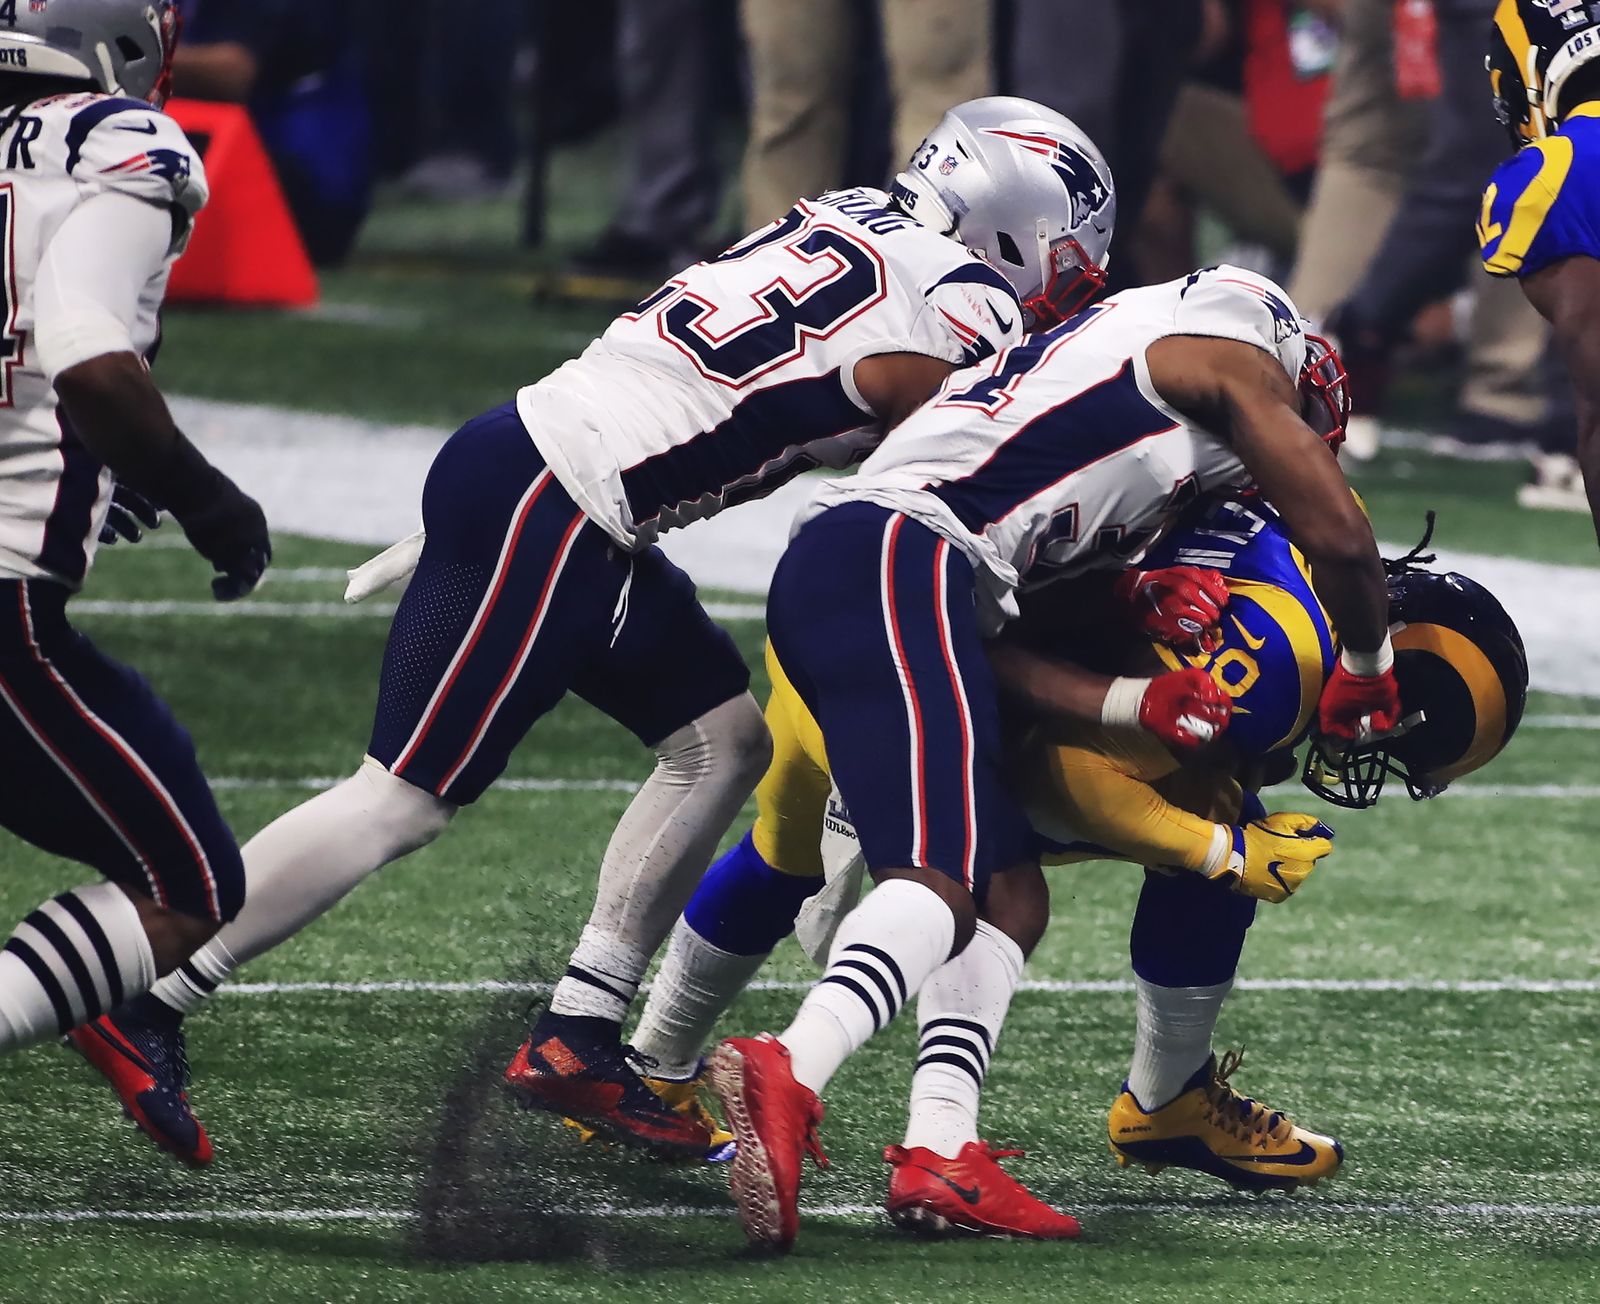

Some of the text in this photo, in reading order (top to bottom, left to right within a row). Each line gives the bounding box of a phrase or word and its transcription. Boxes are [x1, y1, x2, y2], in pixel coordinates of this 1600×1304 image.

[1567, 32, 1592, 58] LOS
[0, 115, 43, 169] R
[825, 817, 859, 840] Wilso
